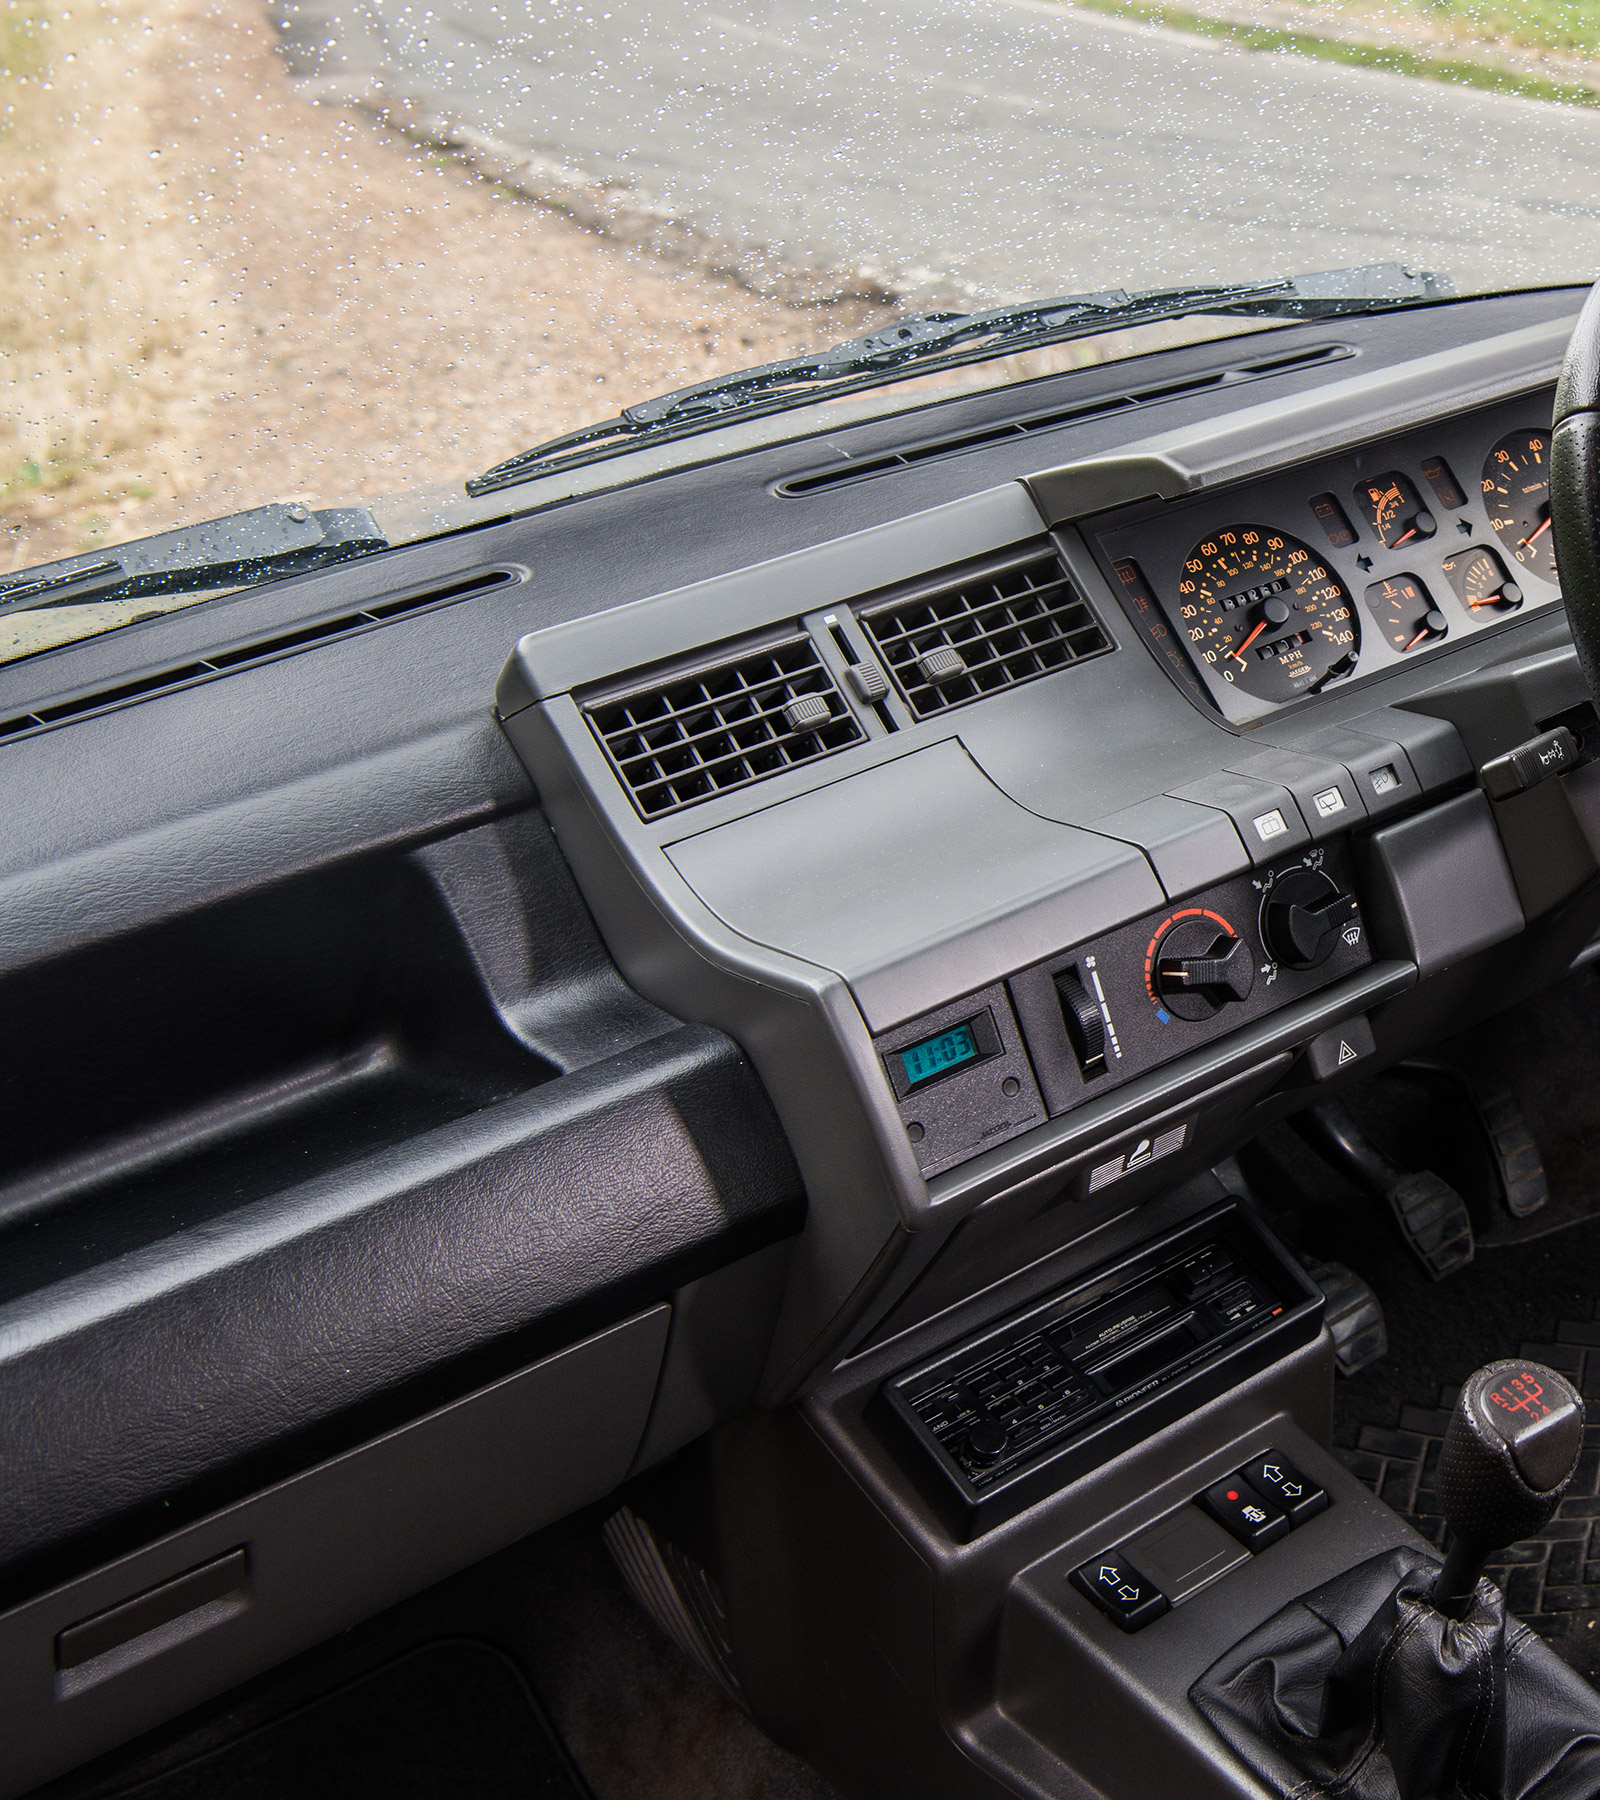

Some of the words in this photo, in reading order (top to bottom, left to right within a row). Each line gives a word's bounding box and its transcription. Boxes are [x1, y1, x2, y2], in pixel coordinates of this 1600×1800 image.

[1529, 438, 1543, 452] 40
[1494, 450, 1510, 464] 30
[1480, 479, 1495, 492] 20
[1382, 510, 1396, 521] 1/2
[1490, 518, 1504, 531] 10
[1219, 532, 1236, 546] 70
[1242, 531, 1259, 545] 80
[1267, 537, 1284, 551] 90
[1200, 542, 1218, 556] 60
[1288, 550, 1309, 565] 100
[1515, 551, 1525, 562] 0
[1186, 558, 1203, 573] 50
[1227, 568, 1239, 577] 100
[1242, 561, 1254, 570] 120
[1260, 562, 1272, 572] 140
[1308, 566, 1328, 582] 110
[1180, 580, 1196, 594] 40
[1216, 580, 1226, 588] 80
[1321, 584, 1341, 601] 120
[1180, 604, 1198, 619] 30
[1304, 604, 1318, 613] 200
[1331, 606, 1351, 623] 130
[1214, 616, 1224, 625] 40
[1310, 620, 1323, 630] 220
[1188, 627, 1204, 642] 20
[1222, 634, 1233, 644] 20
[1332, 630, 1354, 646] 140
[1202, 650, 1218, 664] 10
[1278, 650, 1304, 665] MPH
[1224, 670, 1234, 682] 0
[912, 1029, 971, 1075] 11:03
[1490, 1392, 1506, 1405] R
[1502, 1386, 1513, 1396] 1
[1511, 1378, 1525, 1391] 3
[1521, 1372, 1535, 1384] 5
[1541, 1404, 1552, 1415] 4
